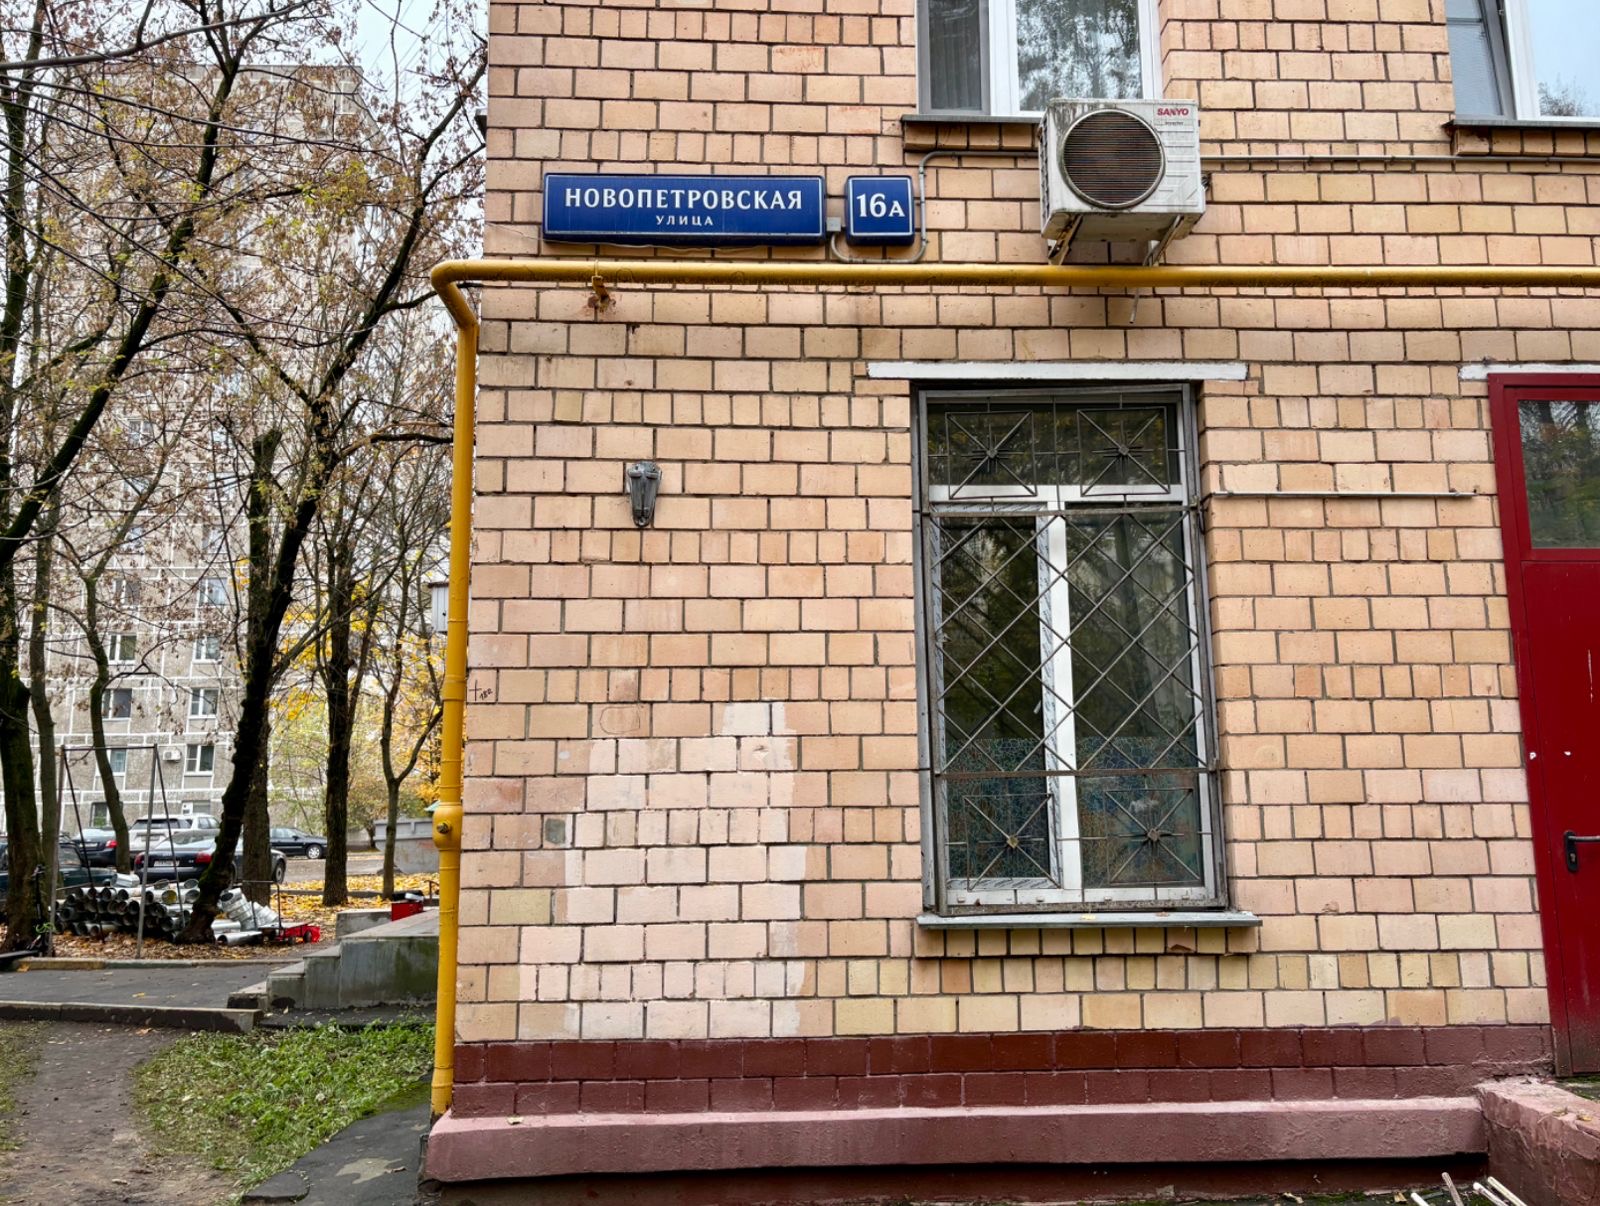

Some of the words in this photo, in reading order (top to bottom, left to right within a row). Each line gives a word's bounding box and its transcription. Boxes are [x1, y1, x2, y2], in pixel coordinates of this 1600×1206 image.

[1157, 107, 1189, 116] SANYO
[565, 188, 802, 210] НОВОПЕТРОВСКАЯ
[856, 193, 905, 218] 16А
[656, 215, 713, 226] УЛИЦА
